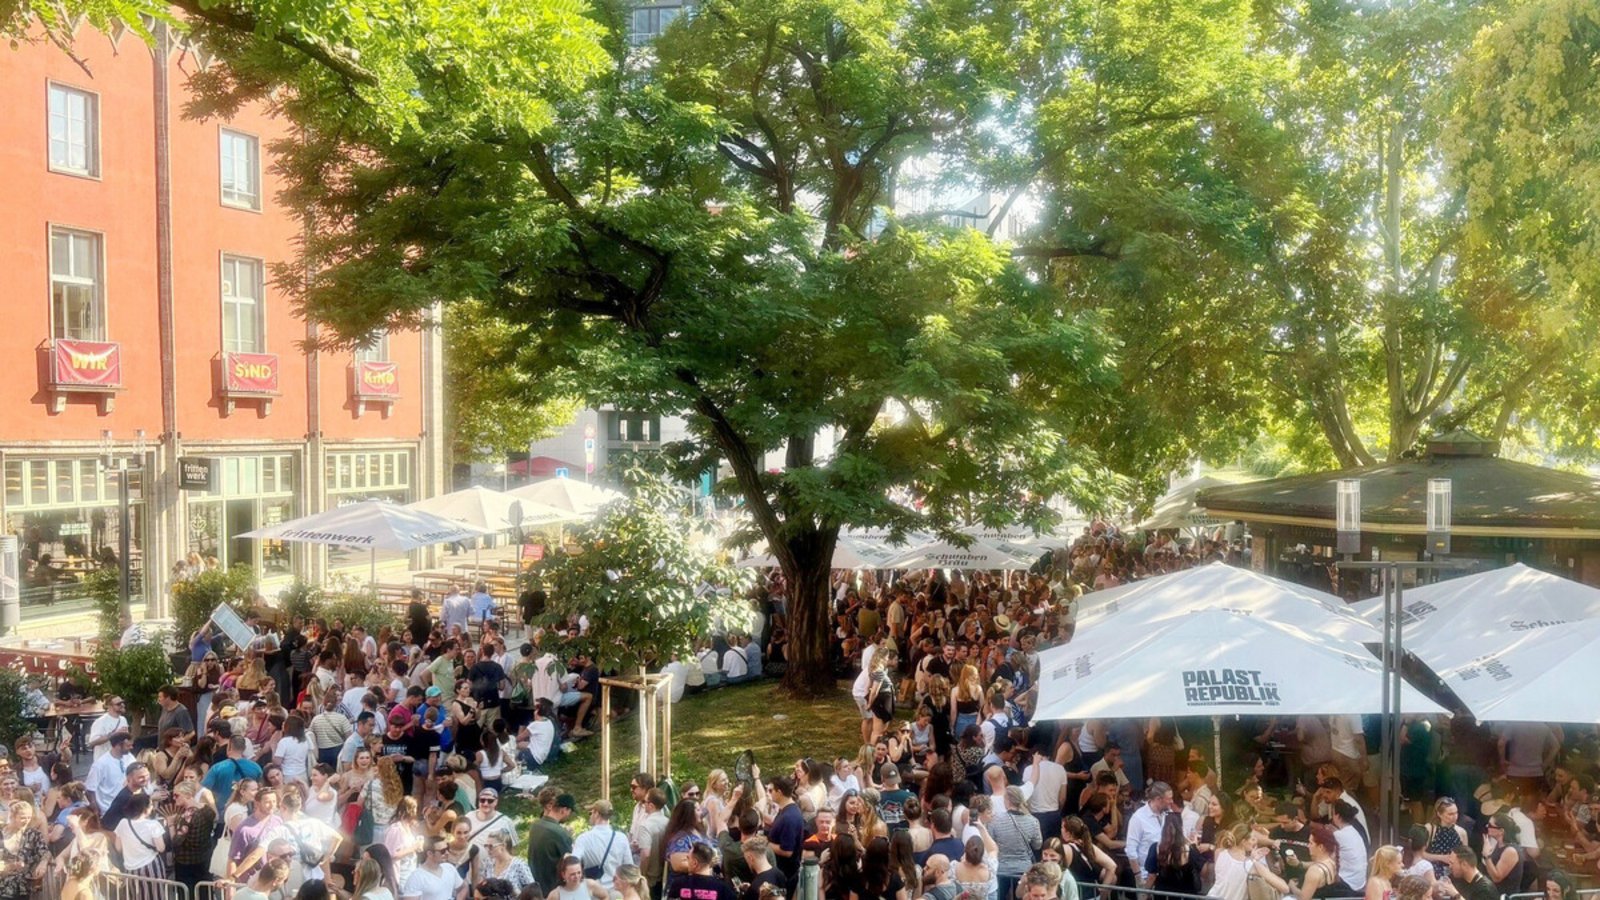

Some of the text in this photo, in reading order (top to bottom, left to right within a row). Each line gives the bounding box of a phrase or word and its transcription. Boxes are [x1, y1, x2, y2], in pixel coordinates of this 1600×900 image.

[184, 463, 208, 473] fritten
[186, 472, 207, 480] werk
[280, 529, 376, 544] frittenwerk
[924, 553, 988, 561] Schwaben
[1182, 668, 1261, 686] PALAST
[1184, 685, 1281, 702] REPUBLIK
